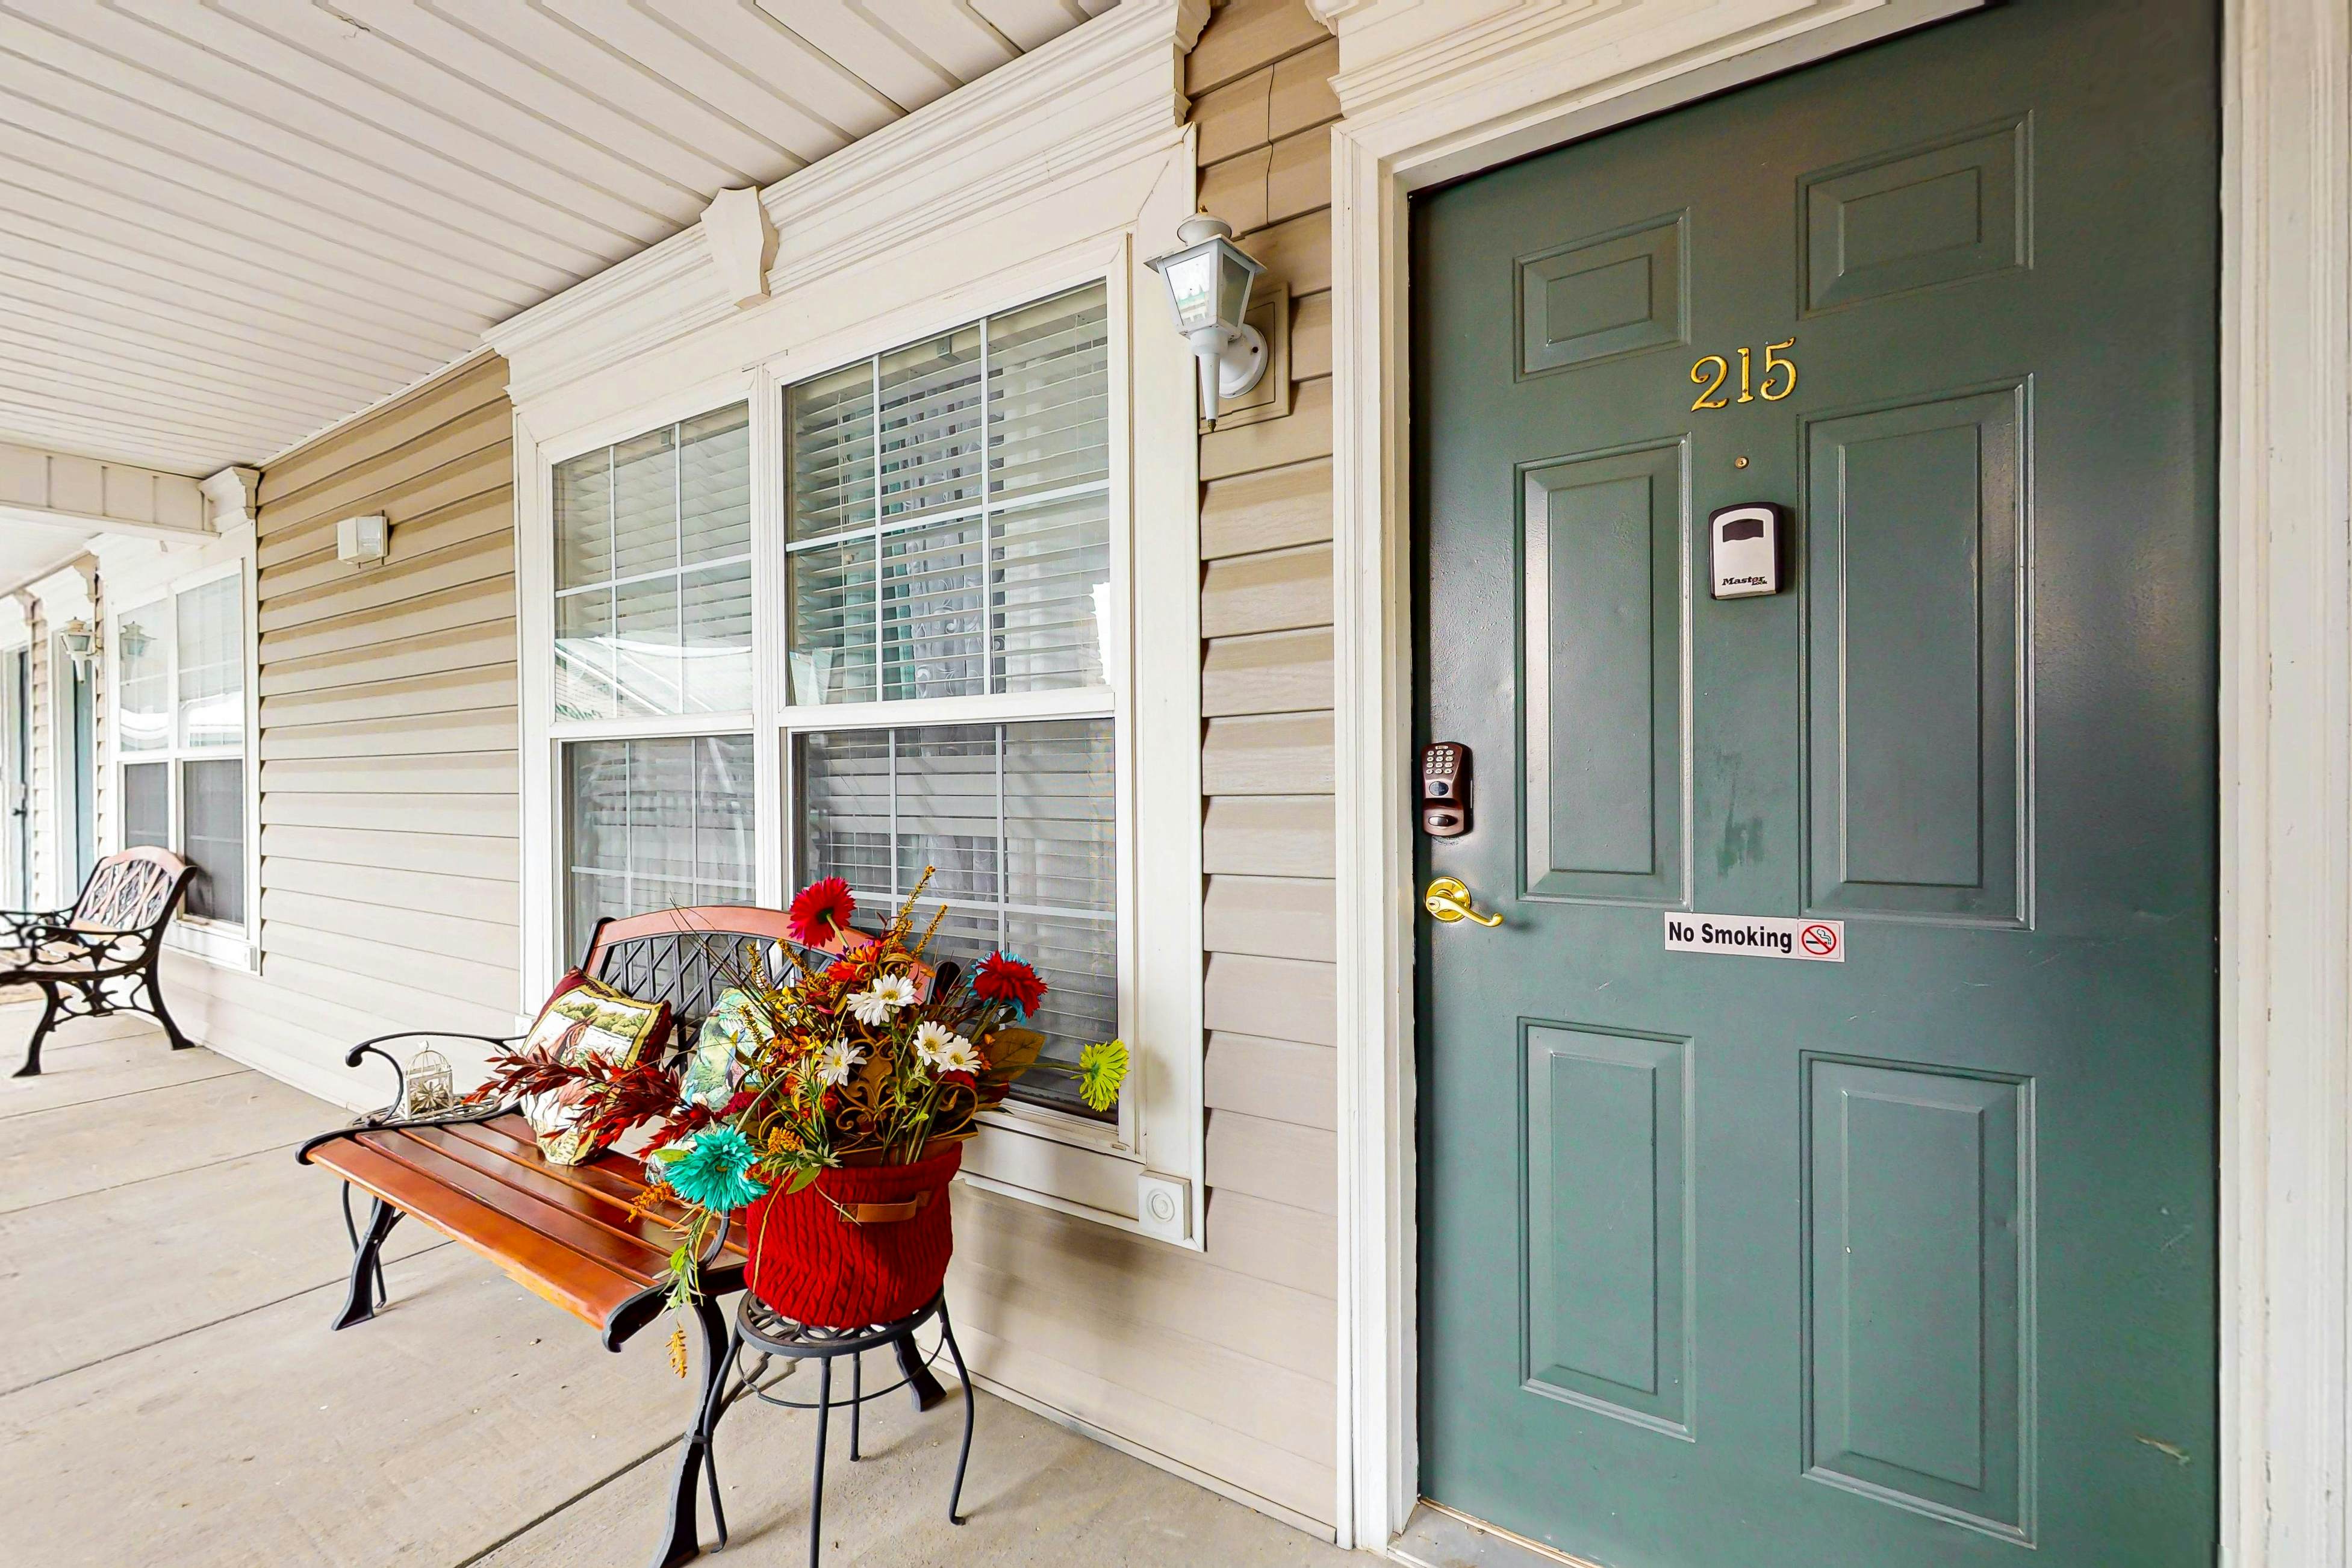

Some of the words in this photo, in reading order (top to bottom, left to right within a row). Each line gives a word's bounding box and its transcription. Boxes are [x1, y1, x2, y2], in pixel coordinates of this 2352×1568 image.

[1690, 337, 1797, 413] 215
[1722, 576, 1765, 585] Master
[1669, 921, 1694, 942] No
[1702, 923, 1792, 954] Smoking
